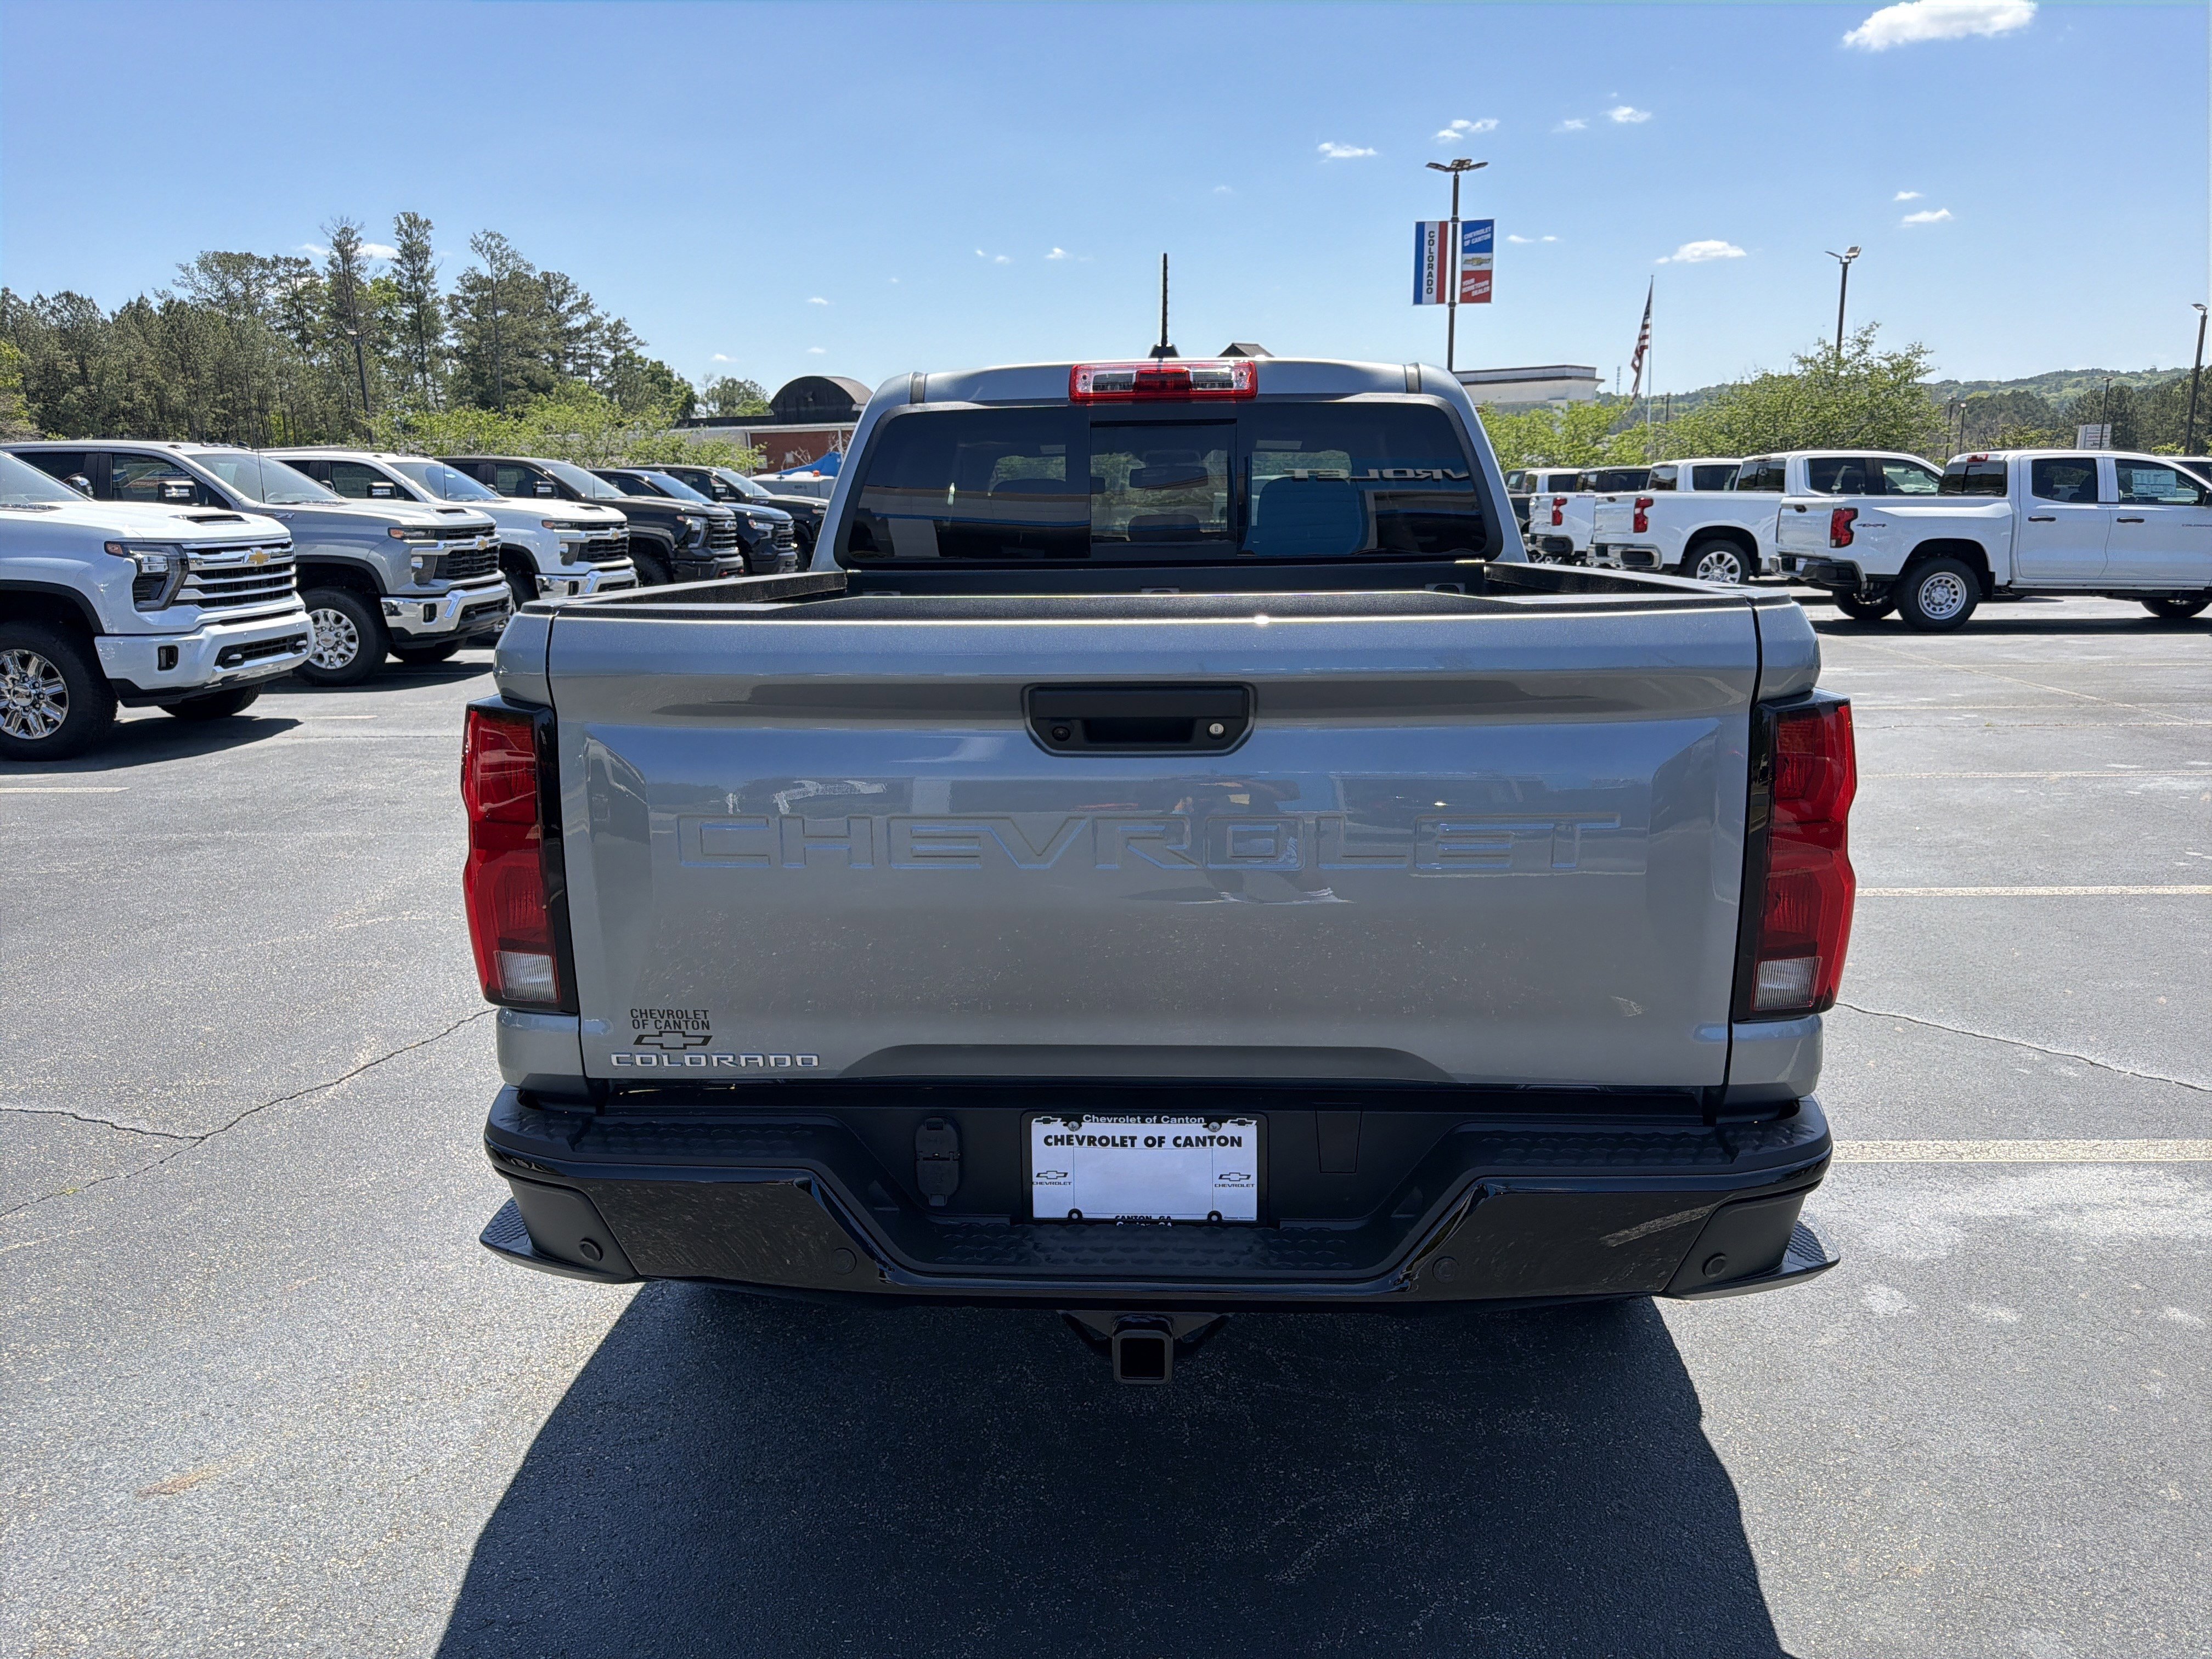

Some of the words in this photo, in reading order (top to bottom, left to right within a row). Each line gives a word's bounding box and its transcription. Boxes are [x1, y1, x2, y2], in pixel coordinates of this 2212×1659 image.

[1426, 230, 1435, 295] COLORADO
[678, 813, 1621, 871] CHEVROLET
[630, 1008, 709, 1020] CHEVROLET
[631, 1019, 649, 1030] OF
[654, 1019, 710, 1030] CANTON
[611, 1053, 819, 1068] COLORADO
[1082, 1114, 1141, 1124] Chevrolet
[1146, 1115, 1158, 1124] of
[1160, 1115, 1205, 1124] Canton
[1043, 1135, 1138, 1148] CHEVROLET
[1144, 1136, 1166, 1148] OF
[1172, 1135, 1243, 1148] CANTON
